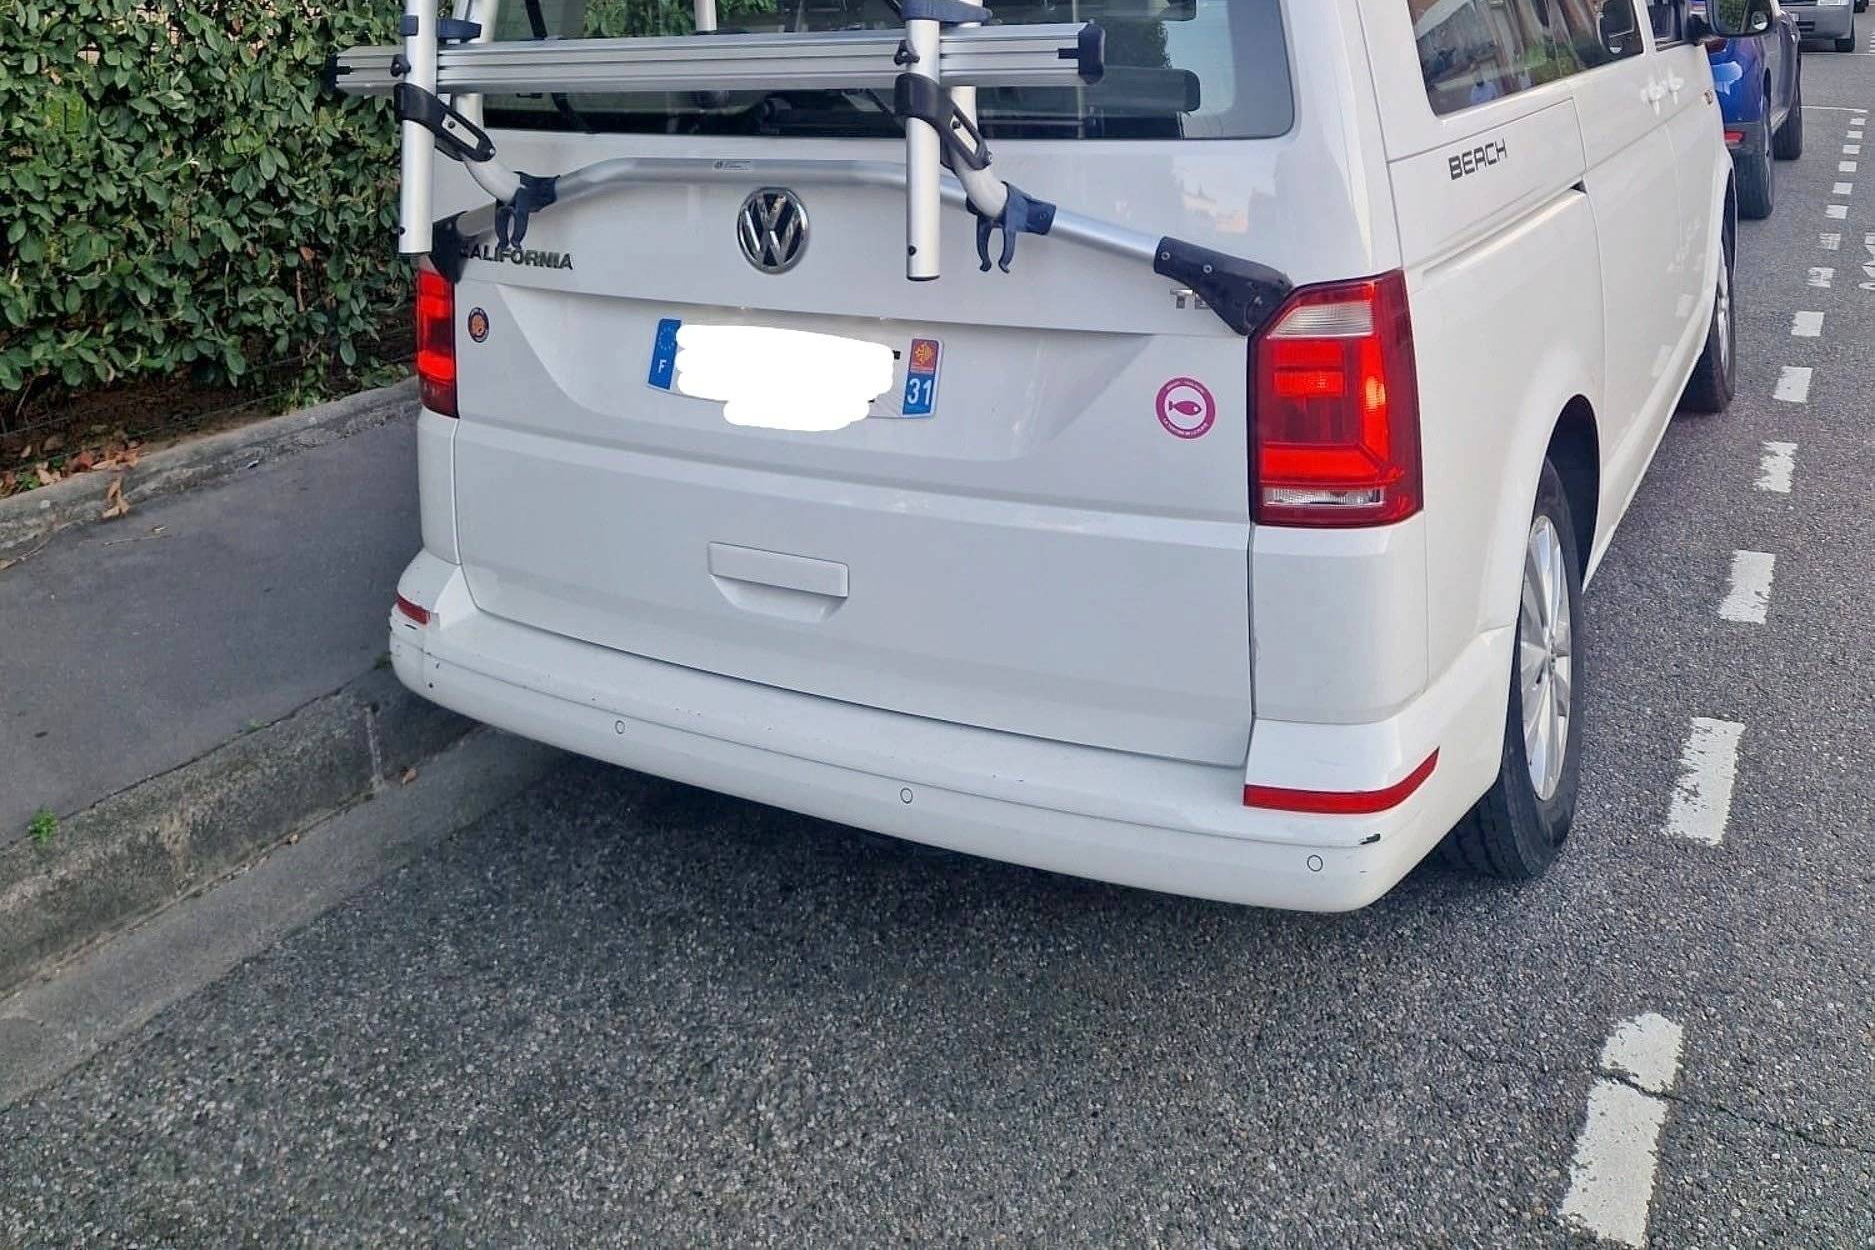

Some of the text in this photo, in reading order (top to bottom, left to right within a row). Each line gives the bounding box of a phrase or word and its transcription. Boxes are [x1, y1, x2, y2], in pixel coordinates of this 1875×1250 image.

[1448, 138, 1508, 180] BEACH
[739, 188, 809, 274] VW
[658, 359, 667, 374] F
[907, 378, 932, 406] 31
